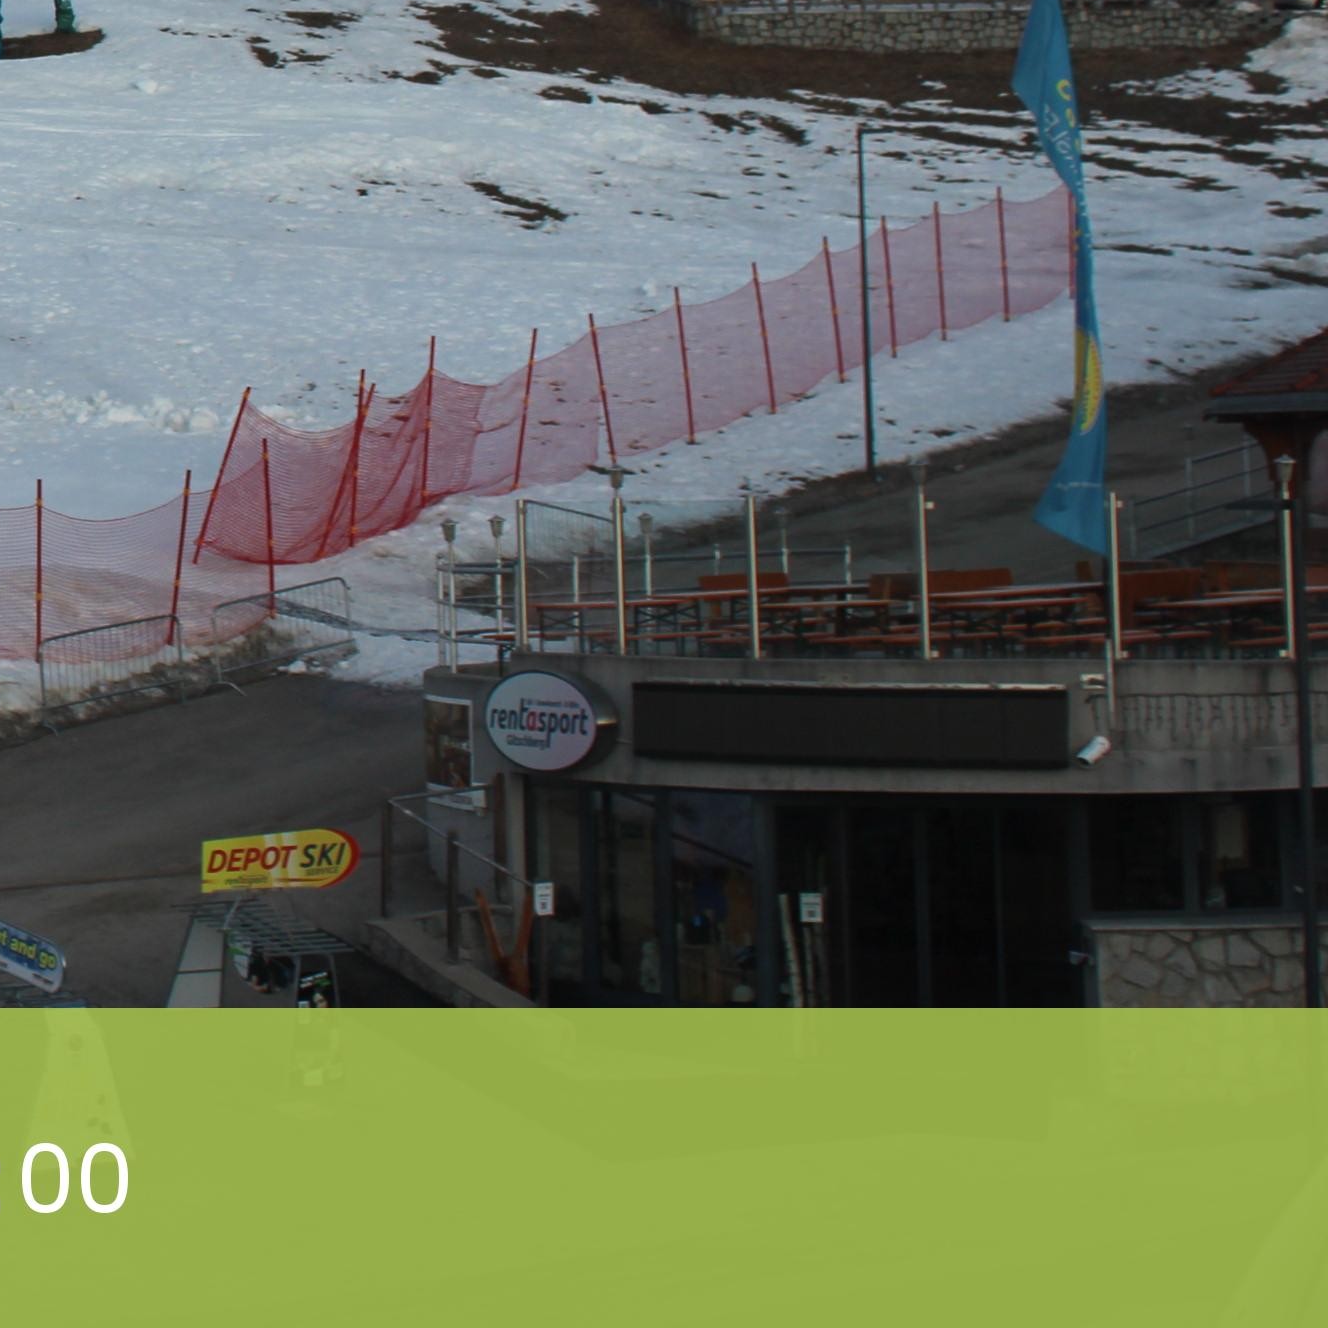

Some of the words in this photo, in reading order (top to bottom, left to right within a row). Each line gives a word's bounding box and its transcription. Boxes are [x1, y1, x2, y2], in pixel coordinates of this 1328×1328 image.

[489, 697, 589, 748] rentasport
[207, 845, 298, 874] DEPOT
[299, 842, 347, 869] SKI
[9, 937, 37, 961] and
[39, 951, 57, 970] go
